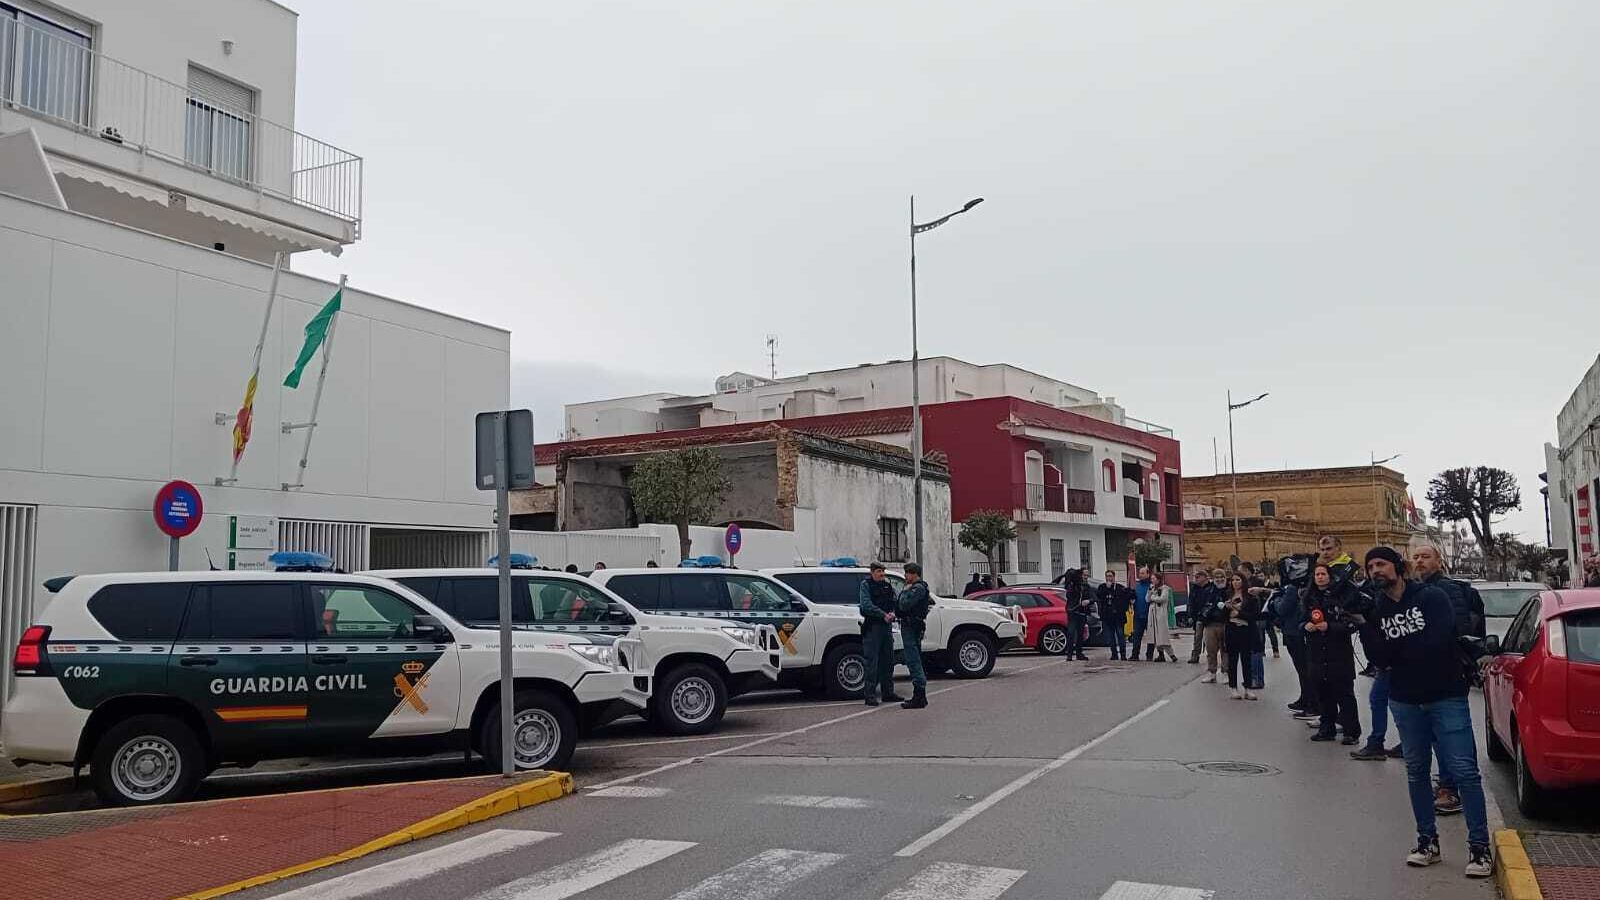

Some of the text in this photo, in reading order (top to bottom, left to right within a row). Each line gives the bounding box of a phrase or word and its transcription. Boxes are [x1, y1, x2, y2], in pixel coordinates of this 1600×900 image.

[73, 665, 100, 678] 062
[210, 674, 367, 694] GUARDIA CIVIL
